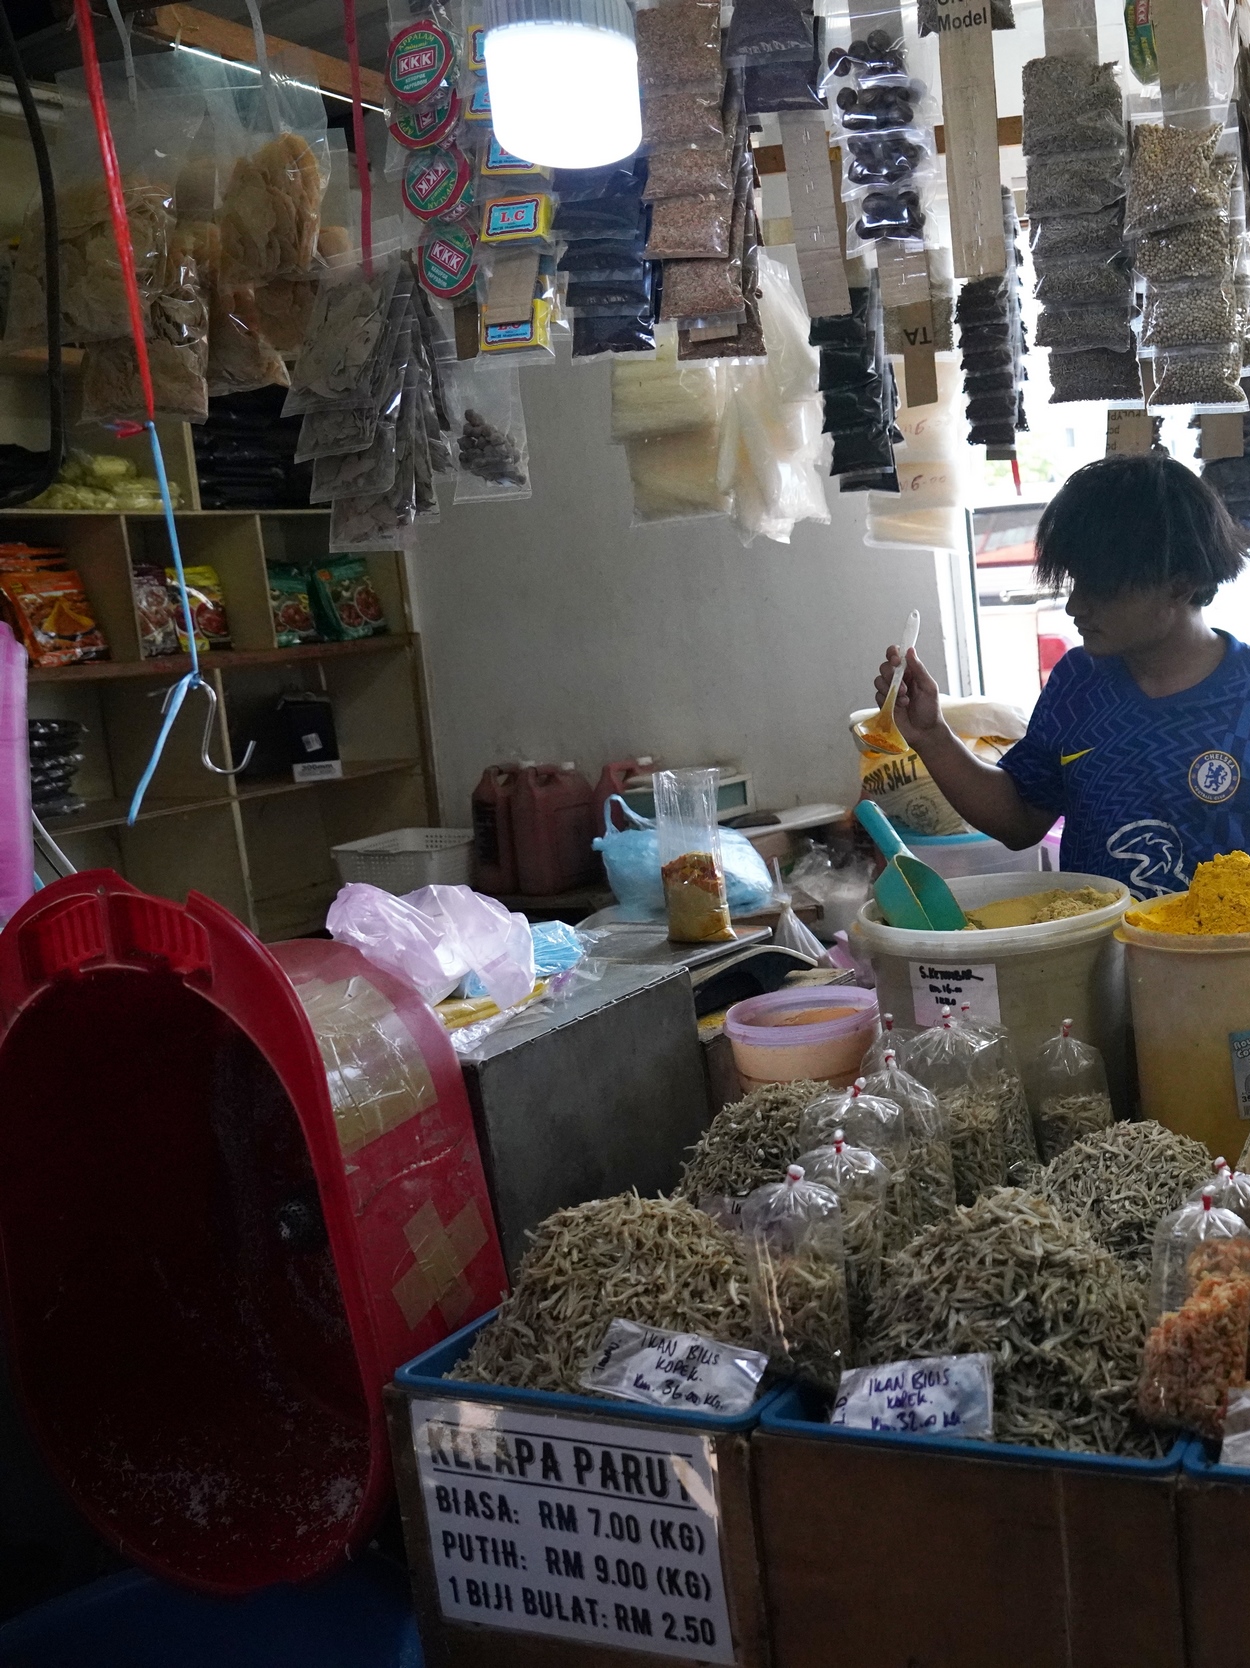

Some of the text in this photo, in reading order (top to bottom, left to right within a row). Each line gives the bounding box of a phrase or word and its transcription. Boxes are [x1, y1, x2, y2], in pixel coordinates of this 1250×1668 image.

[937, 7, 988, 32] Model
[399, 52, 433, 73] KKK
[416, 163, 449, 194] KKK
[432, 240, 464, 270] KKK
[903, 326, 932, 346] TA
[883, 754, 918, 791] SALT
[1204, 753, 1236, 769] CHELSEA
[641, 1331, 678, 1357] IKAN
[427, 1425, 562, 1484] KELAPA
[435, 1484, 706, 1555] BIASA: RM 7.00 (KG)
[441, 1530, 712, 1602] PUTIH: RM 9.00 (KG)
[448, 1575, 717, 1647] 1 BIJI BULAT: RM 2.50
